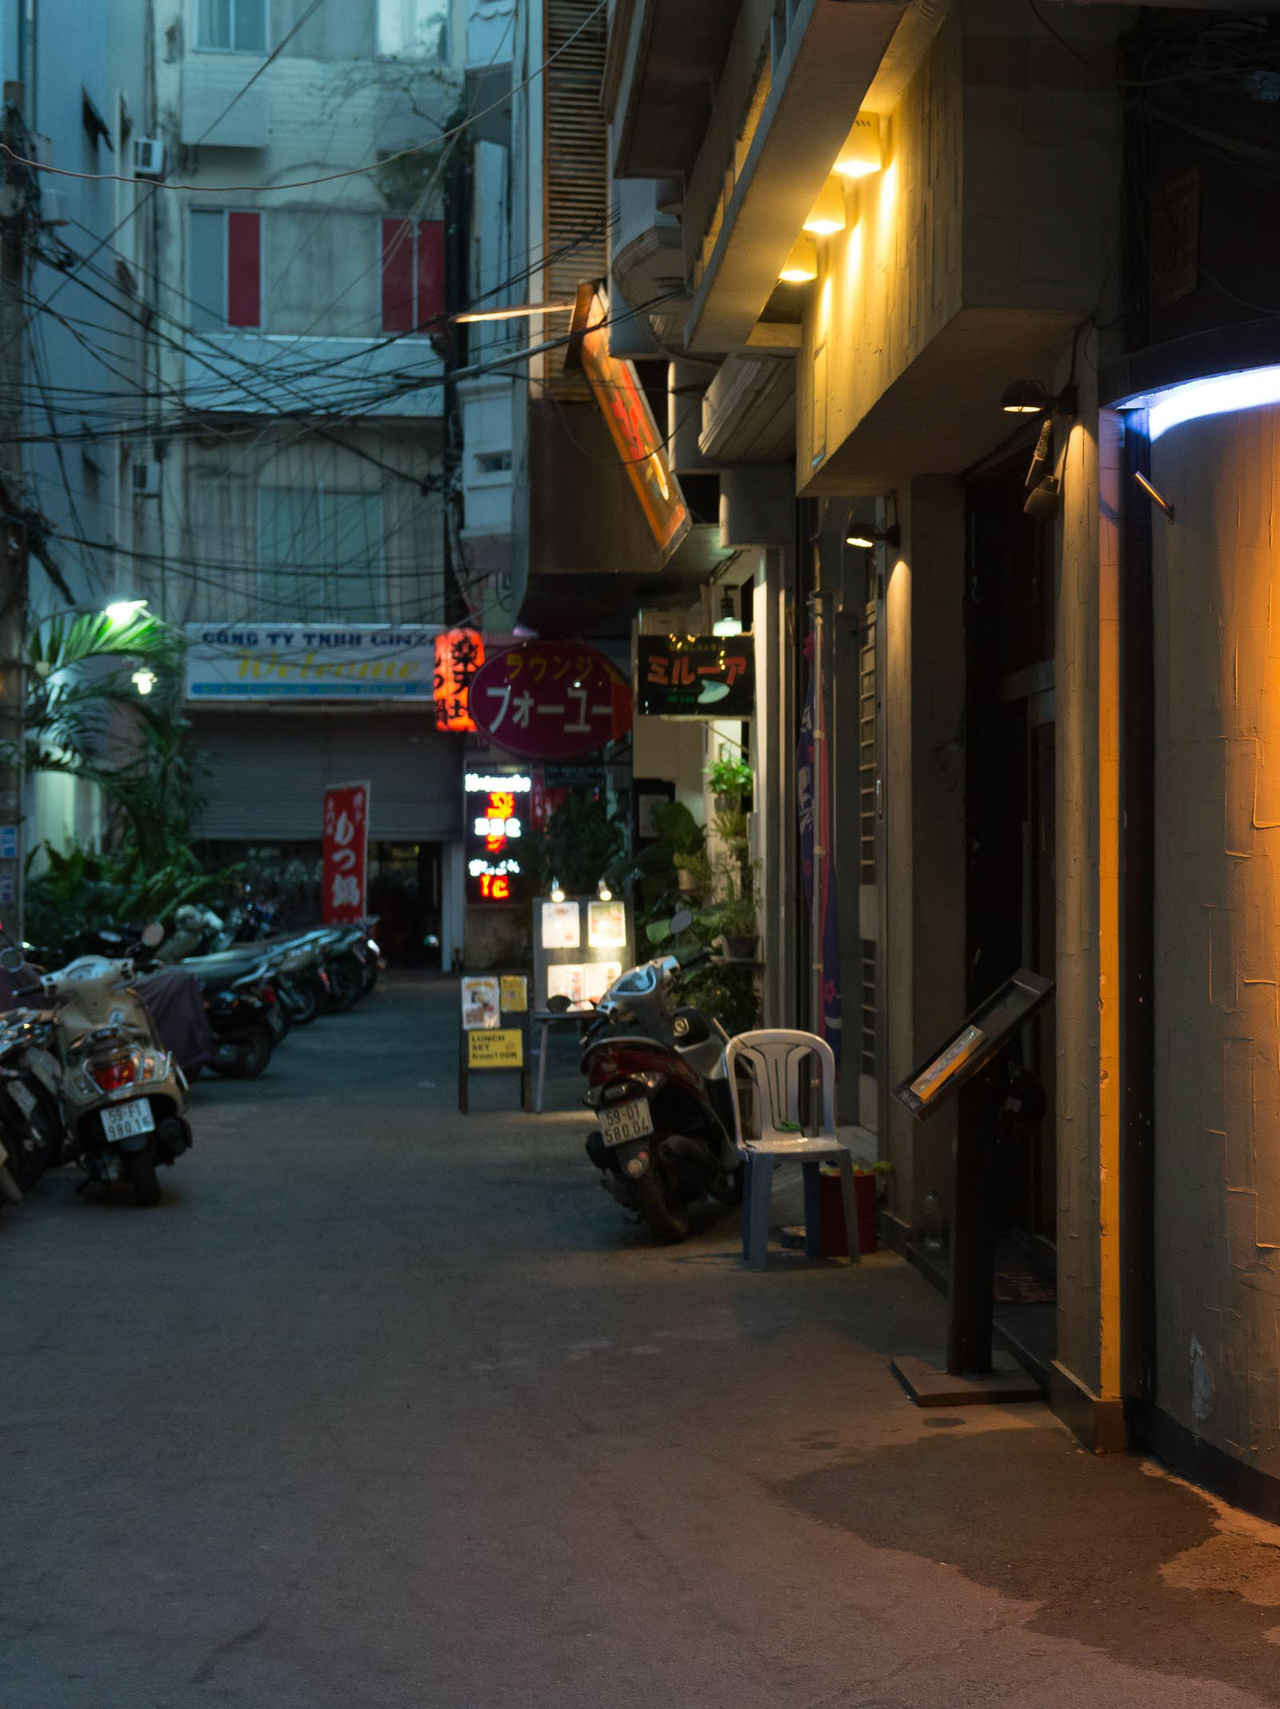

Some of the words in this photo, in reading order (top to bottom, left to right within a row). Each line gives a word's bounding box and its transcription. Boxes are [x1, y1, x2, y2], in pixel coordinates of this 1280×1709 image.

[266, 630, 295, 646] TY
[234, 650, 419, 680] Welcome
[506, 653, 593, 682] ラウンジ
[647, 655, 747, 686] ミルーア
[486, 687, 613, 734] フォーユー
